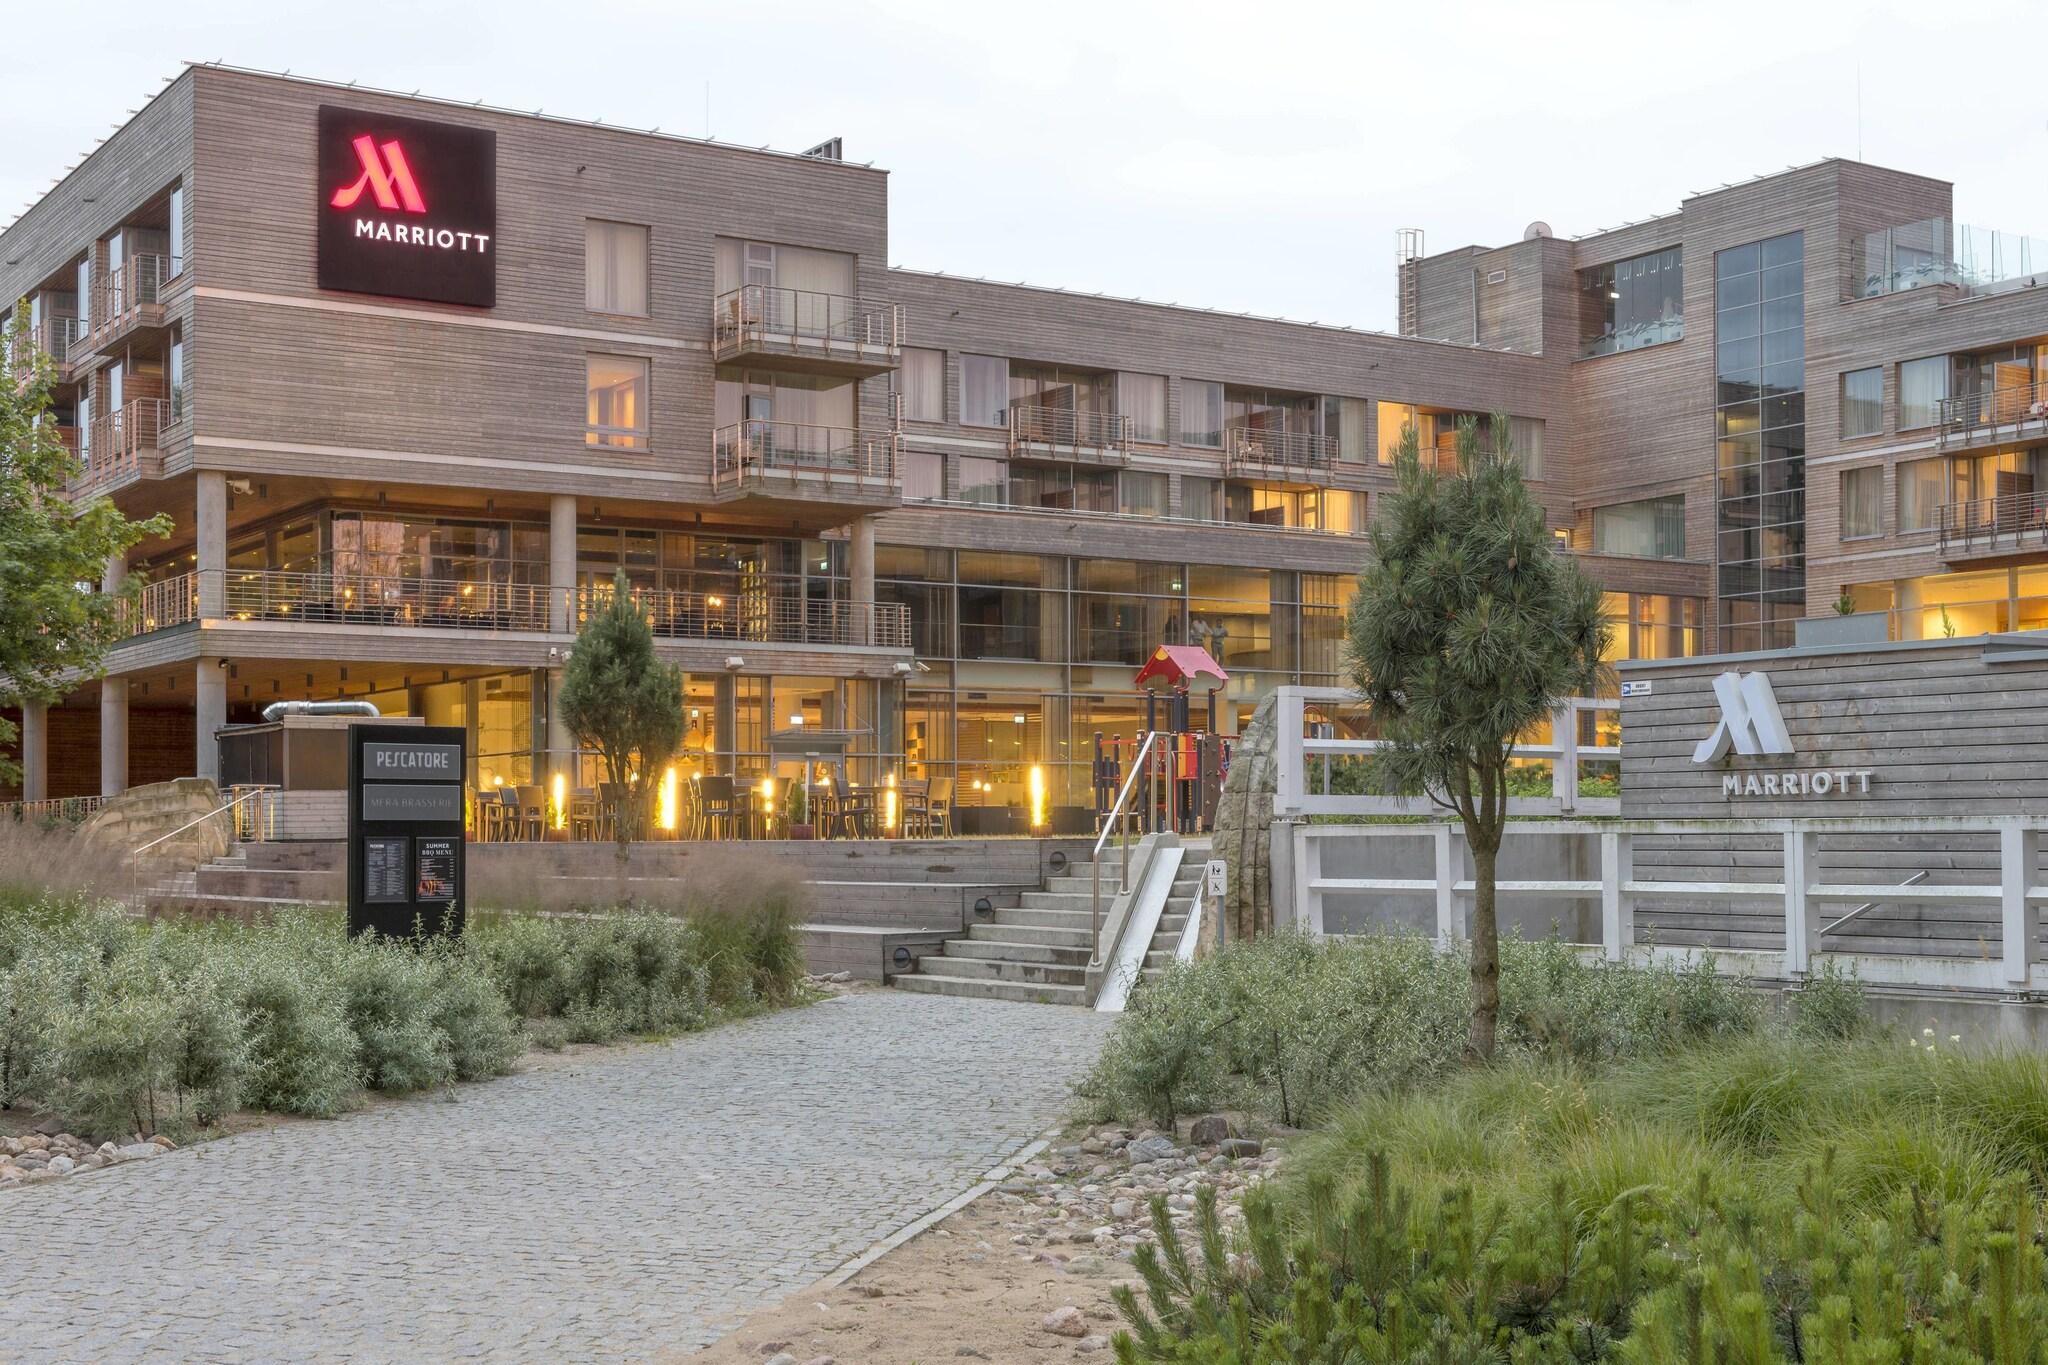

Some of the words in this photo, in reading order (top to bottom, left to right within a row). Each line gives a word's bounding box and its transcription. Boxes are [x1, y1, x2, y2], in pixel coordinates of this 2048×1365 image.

[355, 218, 490, 254] MARRIOTT
[376, 751, 449, 769] PESCATORE
[1722, 771, 1873, 796] MARRIOTT
[369, 797, 399, 808] MERA
[401, 797, 452, 808] BRASSERIE
